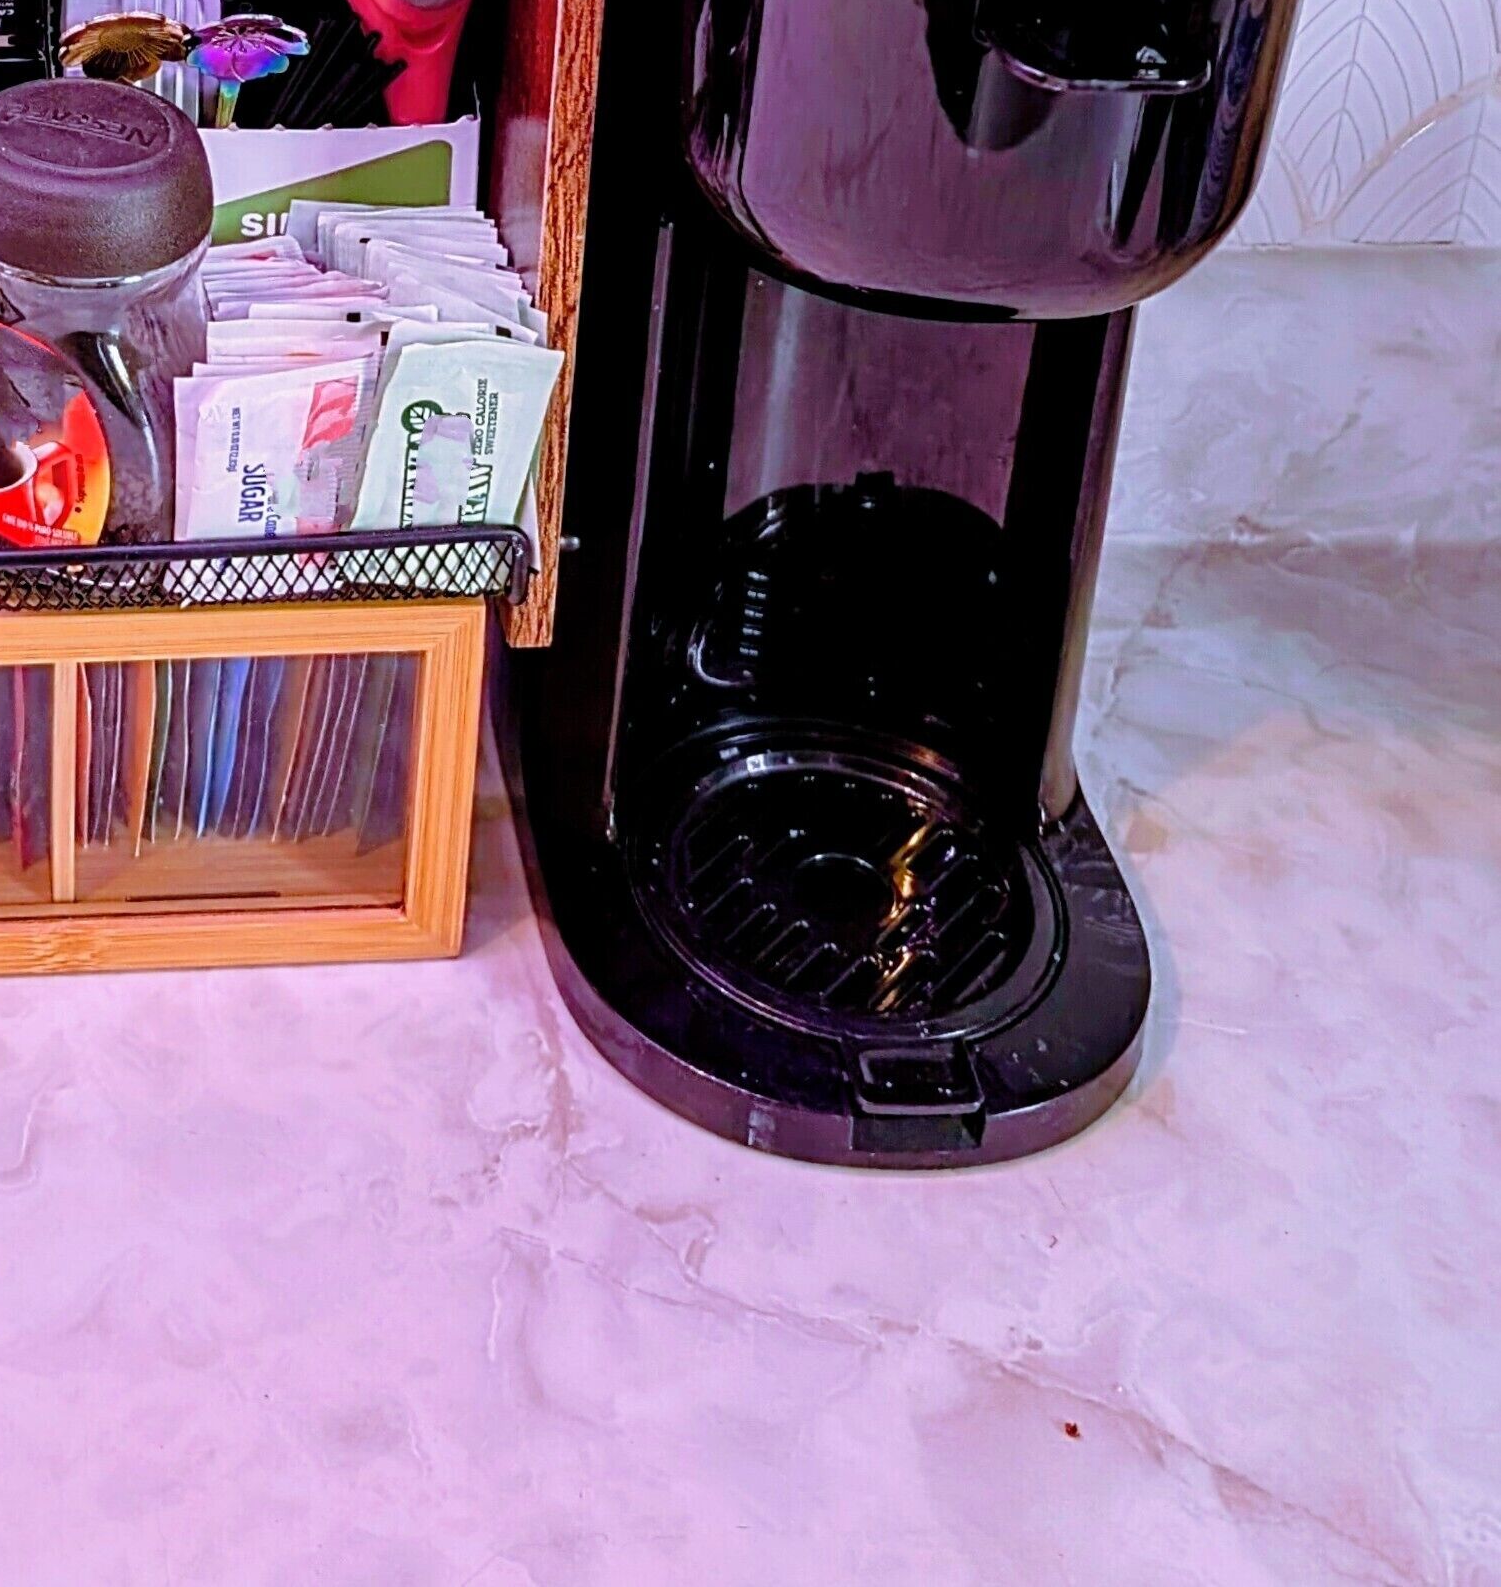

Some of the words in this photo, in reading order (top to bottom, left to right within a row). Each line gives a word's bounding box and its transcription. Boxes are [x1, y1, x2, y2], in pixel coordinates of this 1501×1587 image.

[474, 378, 487, 426] CALORIE
[485, 392, 498, 455] SWEETENER
[472, 429, 483, 455] ZERO
[238, 463, 266, 523] SUGAR
